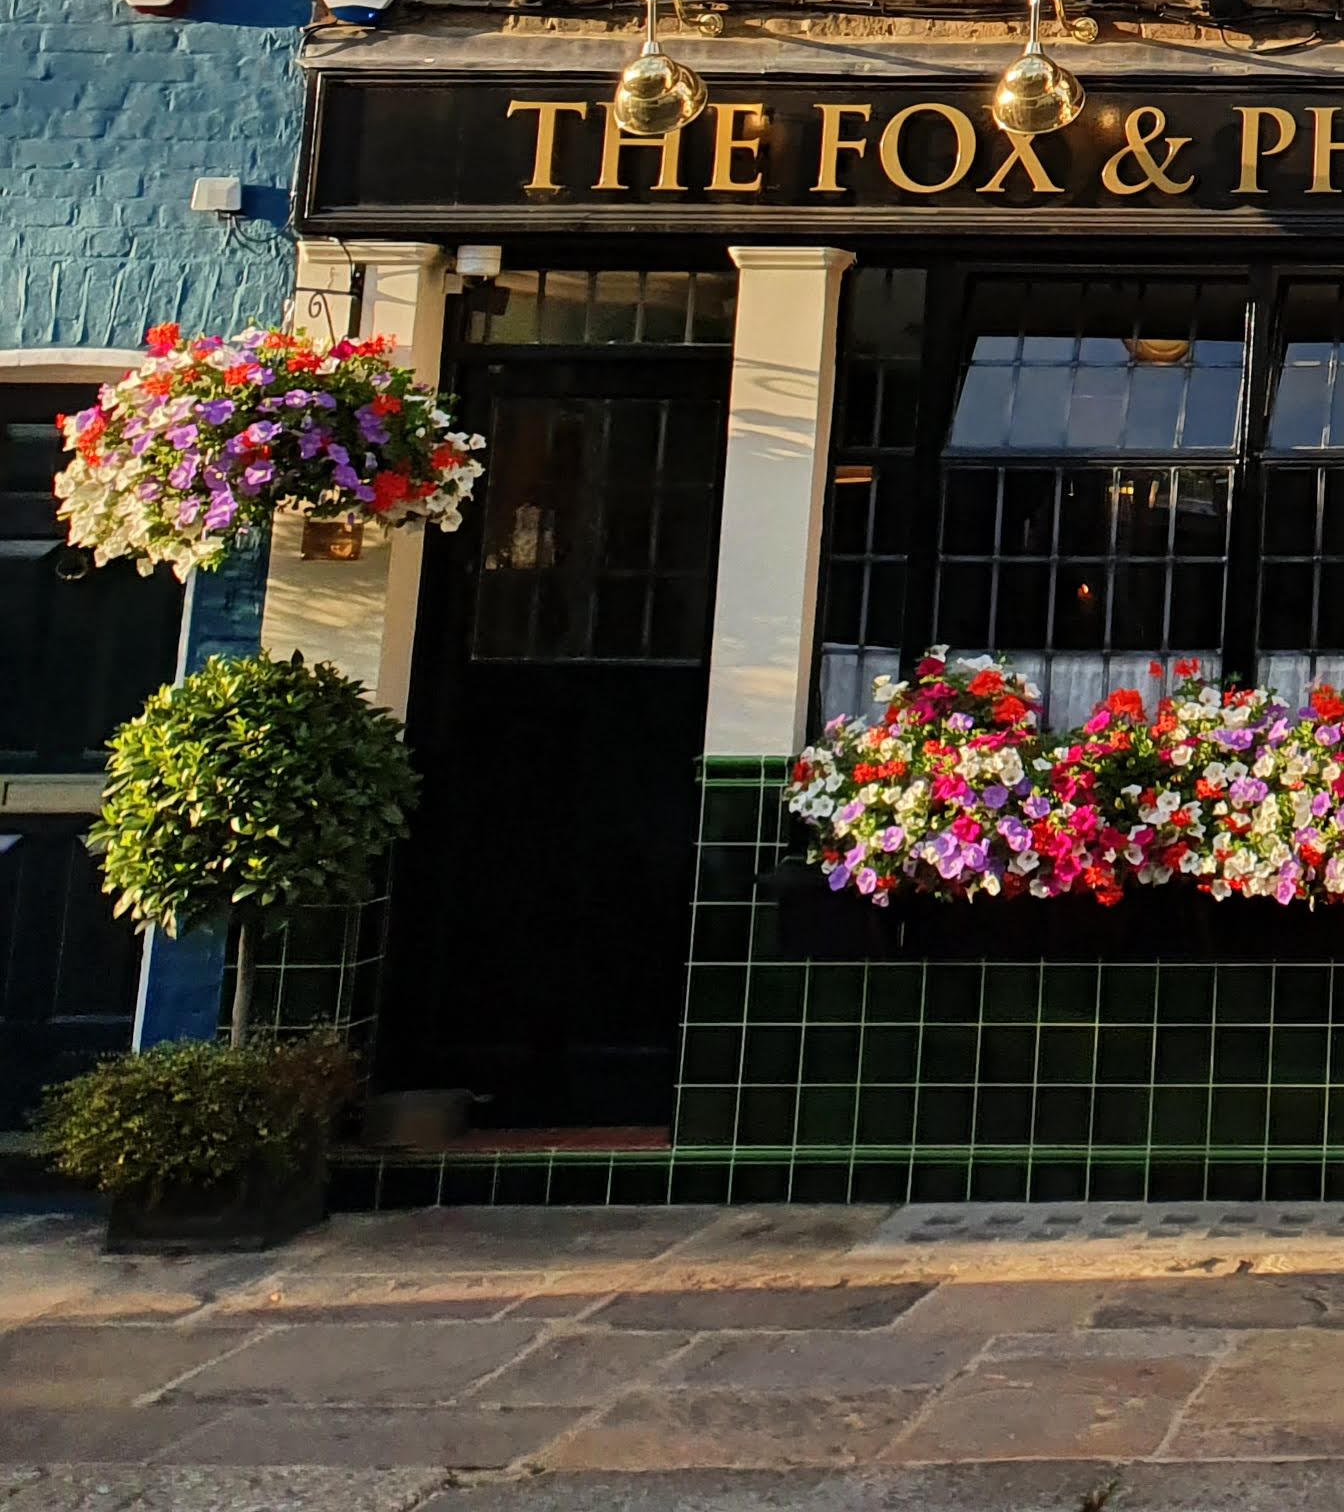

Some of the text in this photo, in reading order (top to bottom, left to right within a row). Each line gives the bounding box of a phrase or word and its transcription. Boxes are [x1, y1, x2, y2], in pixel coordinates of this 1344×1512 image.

[506, 100, 764, 192] THE
[809, 102, 1065, 194] FOX
[1101, 105, 1195, 196] &
